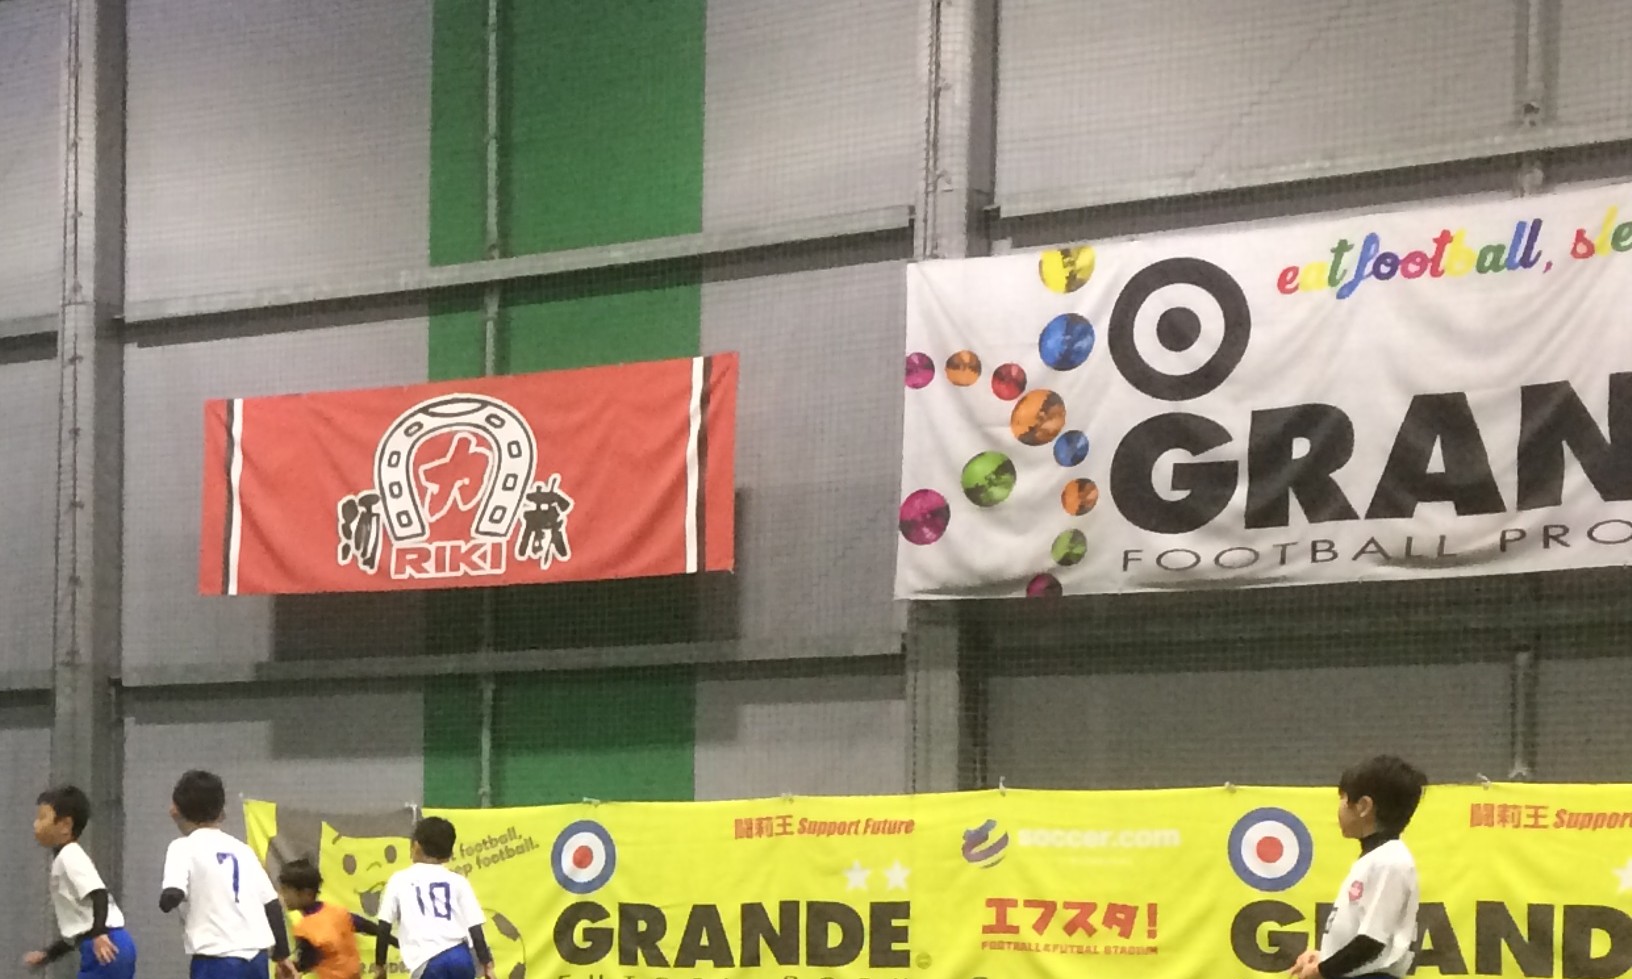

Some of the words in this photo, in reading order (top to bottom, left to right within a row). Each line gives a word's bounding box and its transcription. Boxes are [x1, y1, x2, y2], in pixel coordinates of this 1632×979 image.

[1109, 372, 1632, 534] GRAN
[391, 540, 507, 579] RIKI
[1122, 534, 1458, 572] FOOTBALL
[1499, 518, 1632, 553] PRO
[797, 818, 861, 836] Support
[863, 818, 915, 835] Future
[1553, 808, 1632, 831] Suppor
[216, 852, 240, 903] 7
[411, 882, 451, 921] 10
[553, 900, 910, 969] GRANDE
